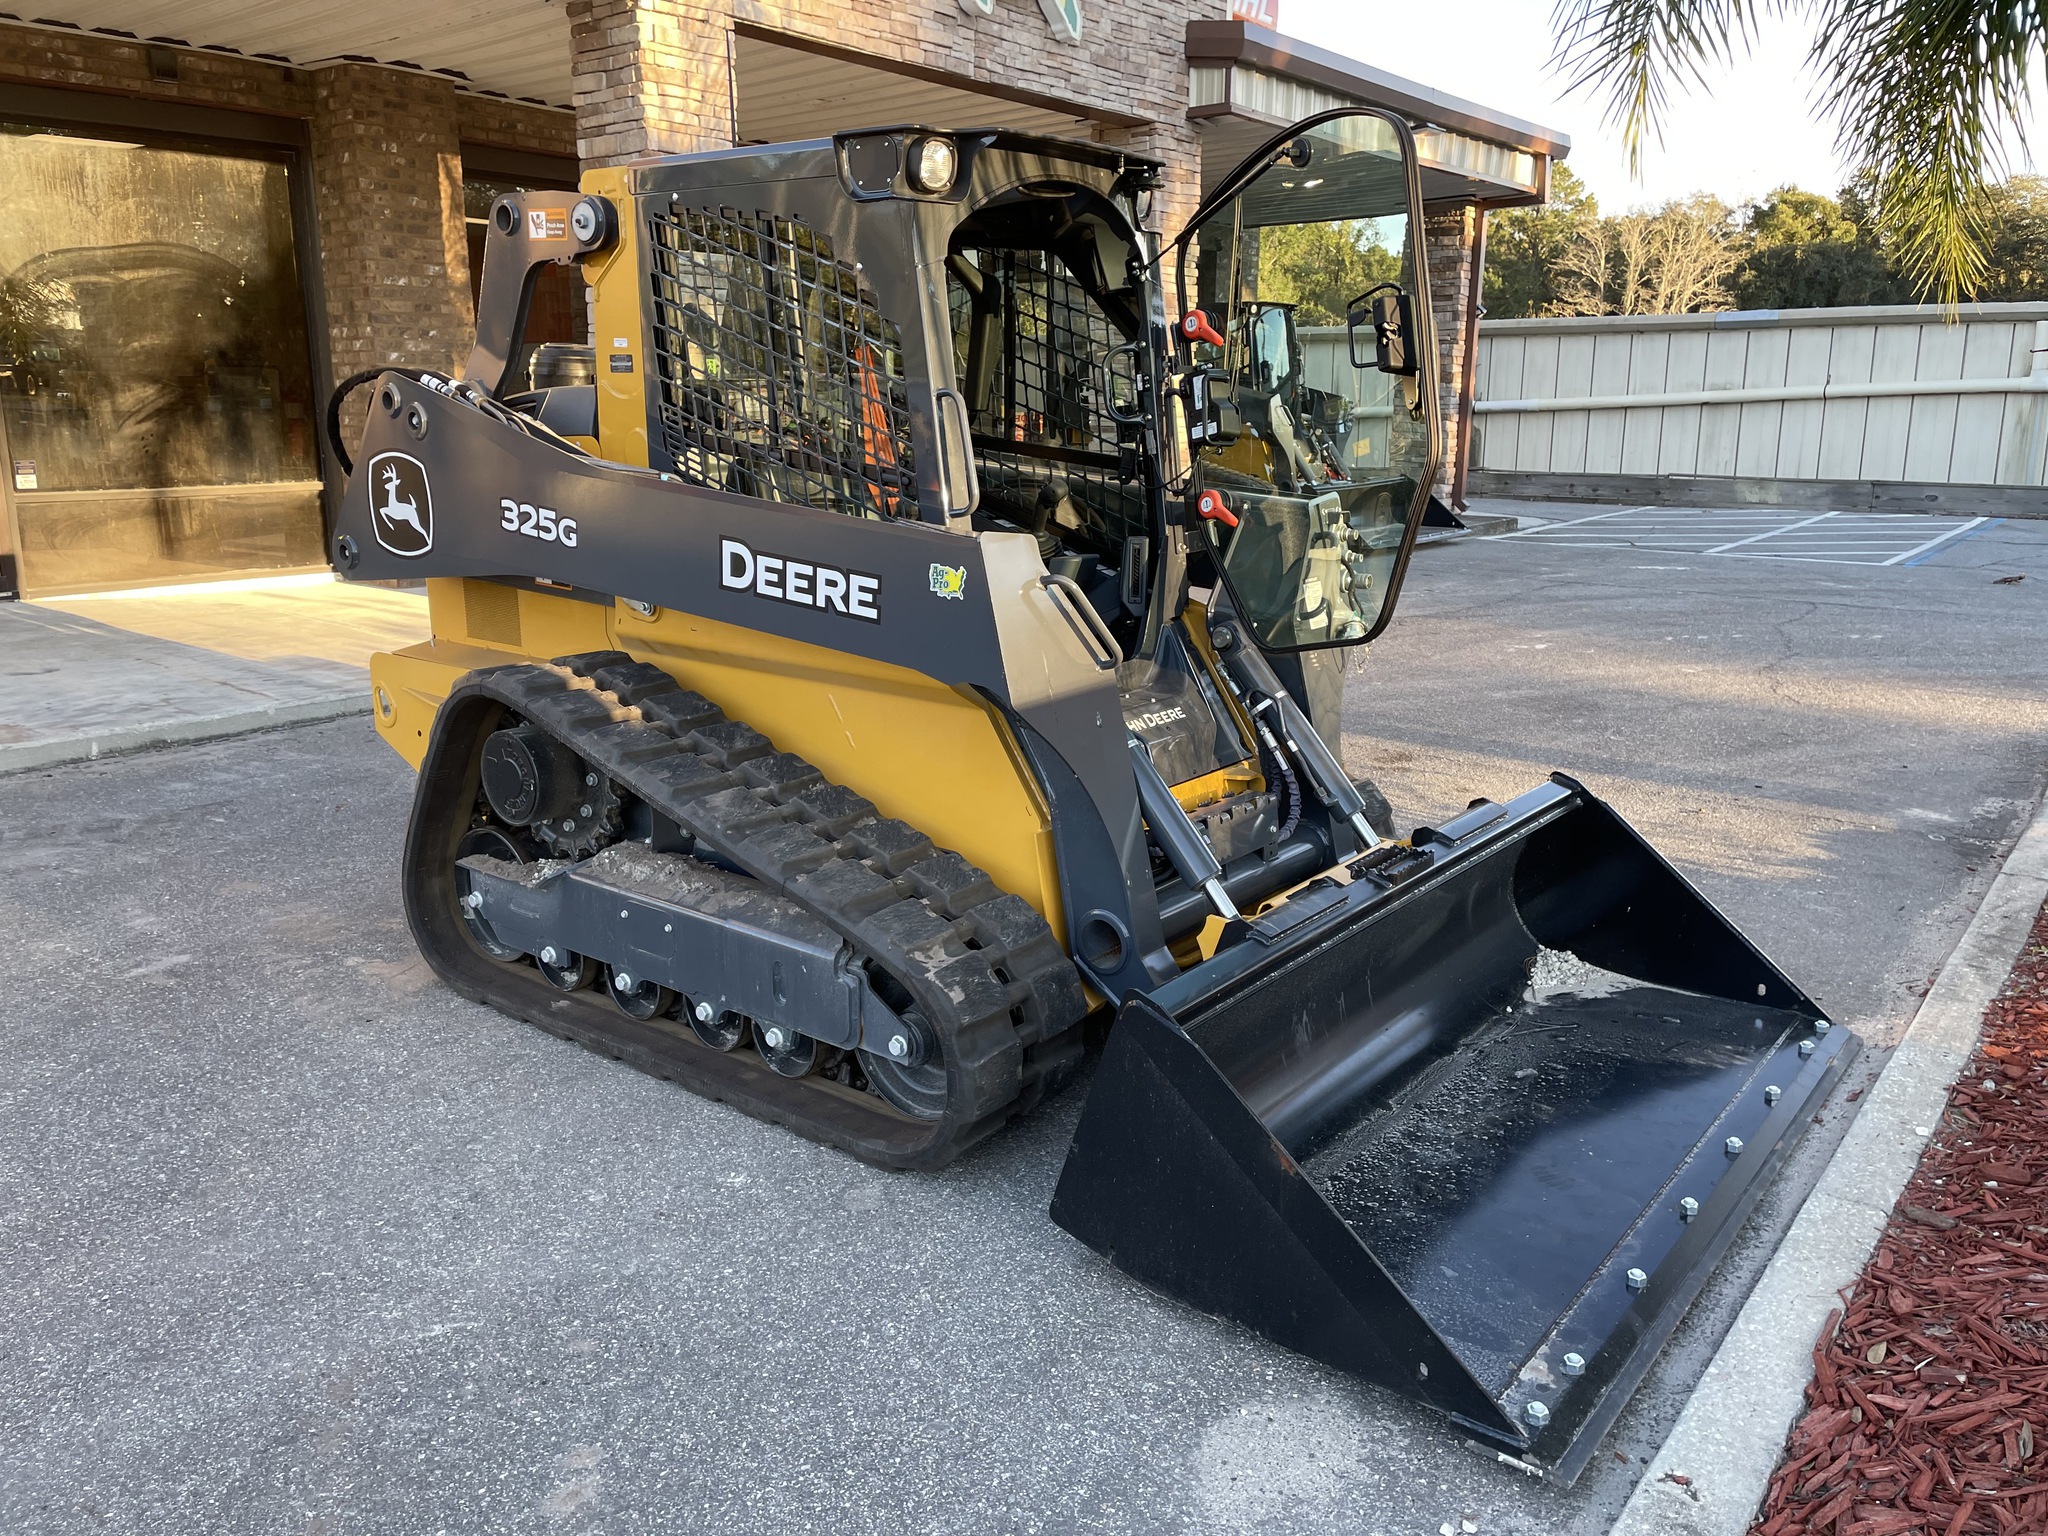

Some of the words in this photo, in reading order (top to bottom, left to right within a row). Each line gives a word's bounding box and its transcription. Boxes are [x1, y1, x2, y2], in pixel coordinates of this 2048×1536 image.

[500, 499, 577, 547] 325G
[722, 539, 879, 620] DEERE
[932, 566, 948, 579] Ag-
[932, 577, 949, 589] Pro
[1125, 717, 1148, 732] HN
[1142, 706, 1187, 728] DEERE
